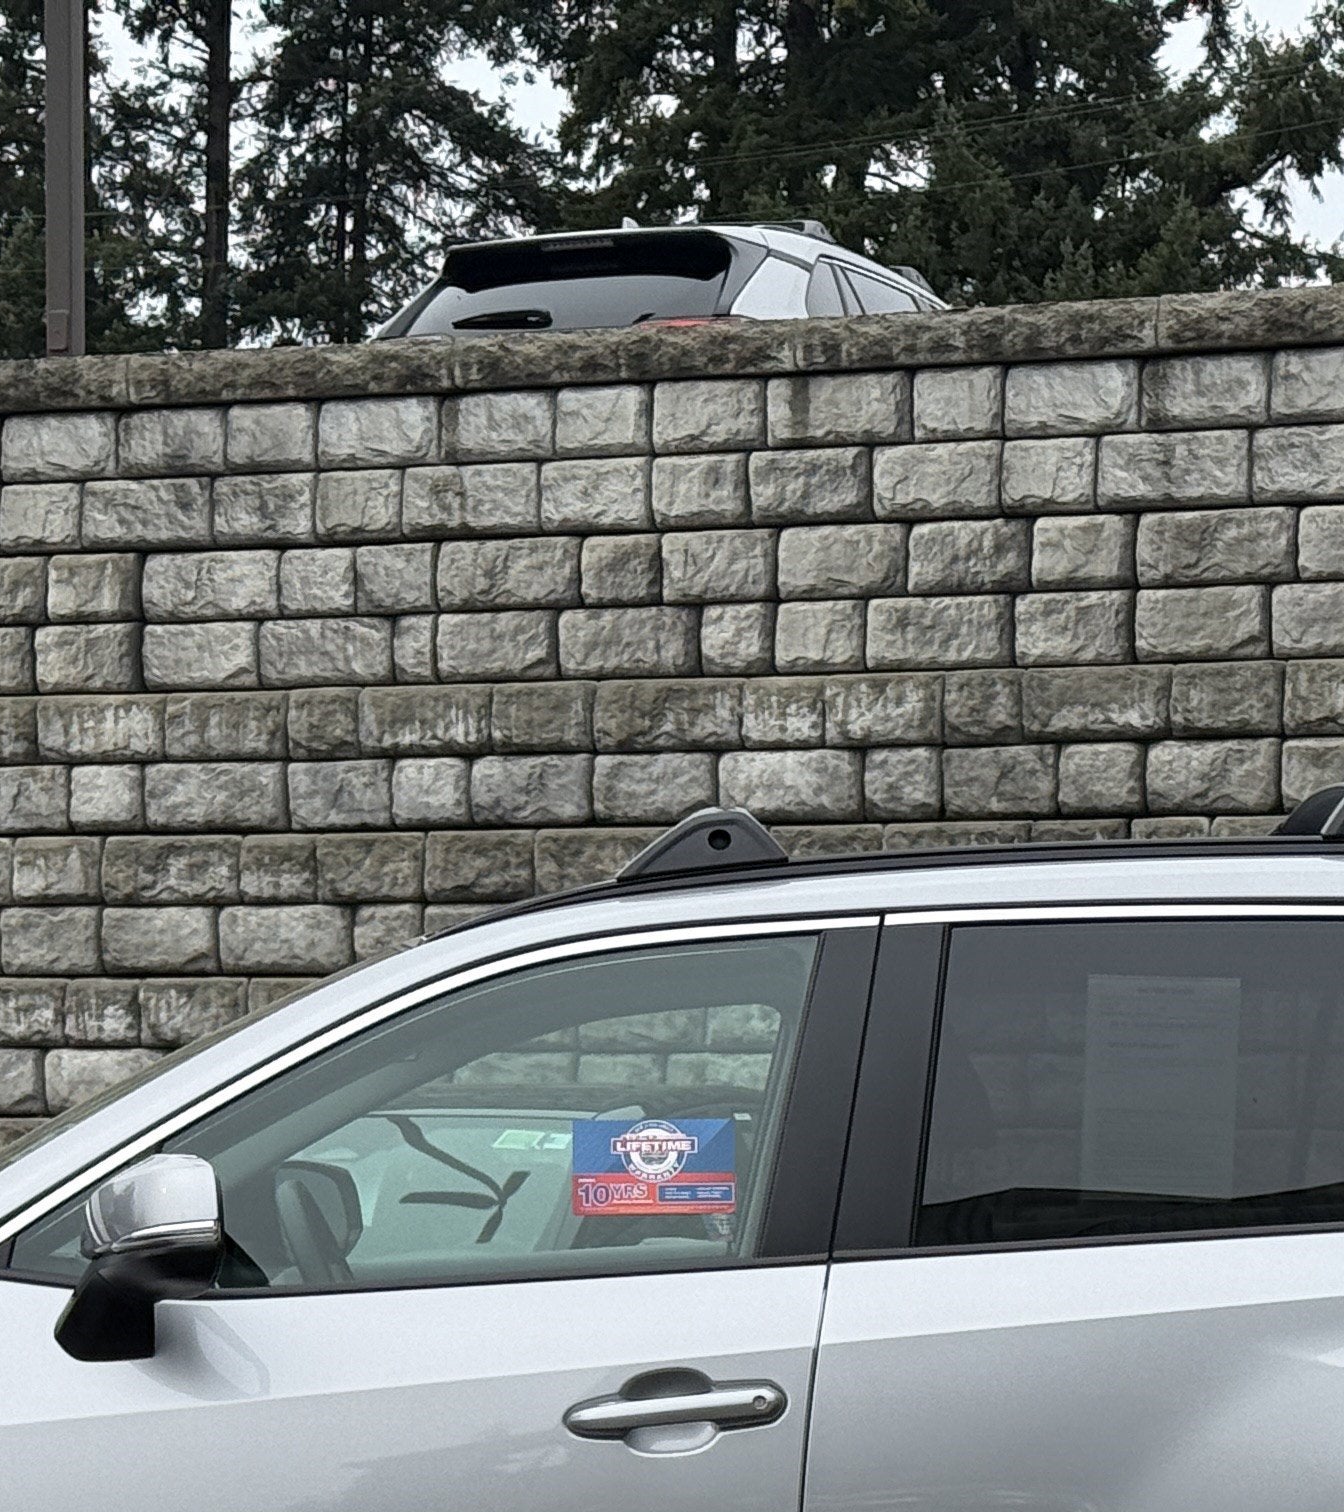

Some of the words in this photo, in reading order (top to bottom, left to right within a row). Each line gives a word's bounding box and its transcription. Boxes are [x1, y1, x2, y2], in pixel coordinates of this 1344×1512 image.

[616, 1140, 692, 1153] LIFETIME
[578, 1183, 611, 1207] 10
[610, 1183, 648, 1199] YRS
